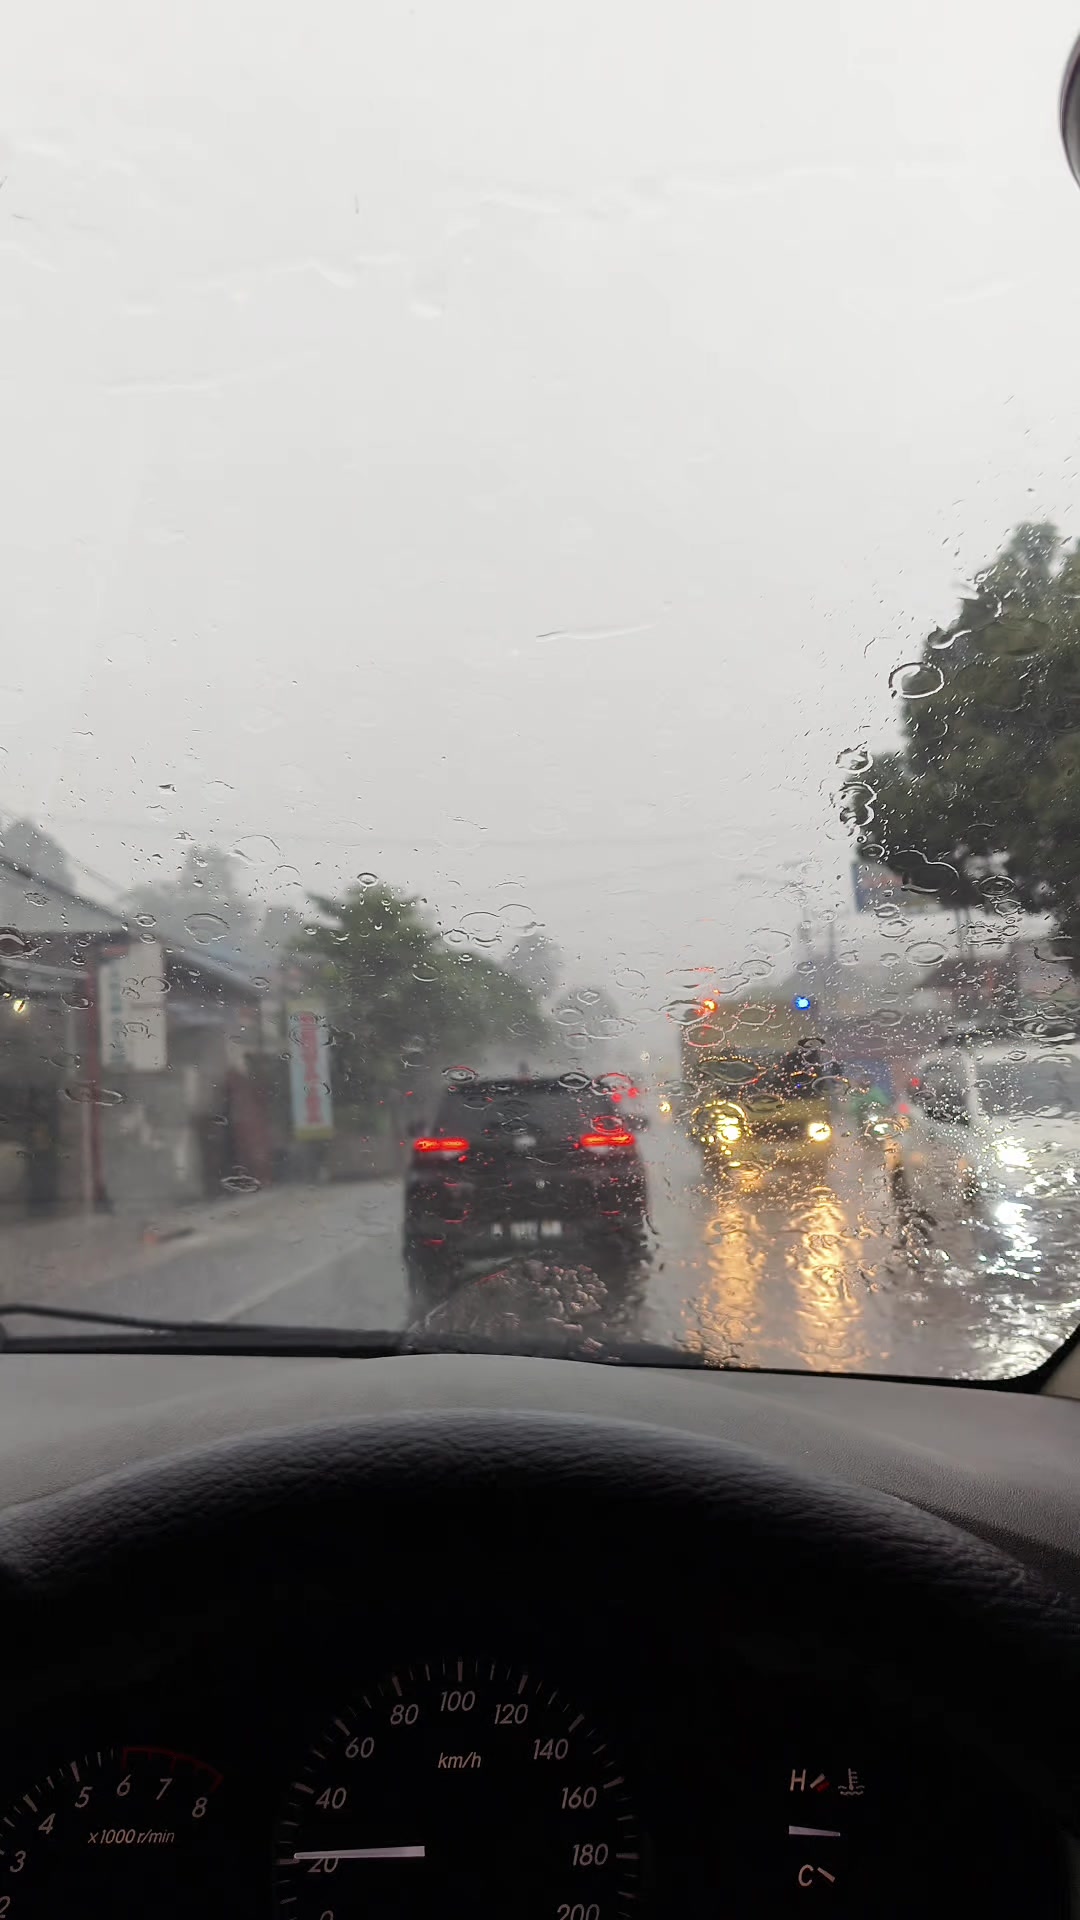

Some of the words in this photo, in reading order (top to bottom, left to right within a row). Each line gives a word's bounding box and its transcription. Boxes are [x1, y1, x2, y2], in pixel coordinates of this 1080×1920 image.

[440, 1690, 476, 1712] 100
[389, 1703, 419, 1725] 80
[494, 1703, 529, 1725] 120
[345, 1736, 375, 1759] 60
[533, 1738, 569, 1760] 140
[437, 1751, 482, 1769] km/h
[116, 1774, 132, 1797] 6
[155, 1777, 173, 1801] 7
[789, 1768, 807, 1792] H
[74, 1786, 93, 1809] 5
[191, 1797, 208, 1819] 8
[315, 1787, 347, 1810] 40
[561, 1786, 598, 1810] 160
[38, 1812, 56, 1835] 4
[9, 1849, 27, 1873] 3
[307, 1856, 340, 1873] 20
[572, 1843, 609, 1867] 180
[797, 1863, 814, 1887] C
[556, 1903, 601, 1920] 200
